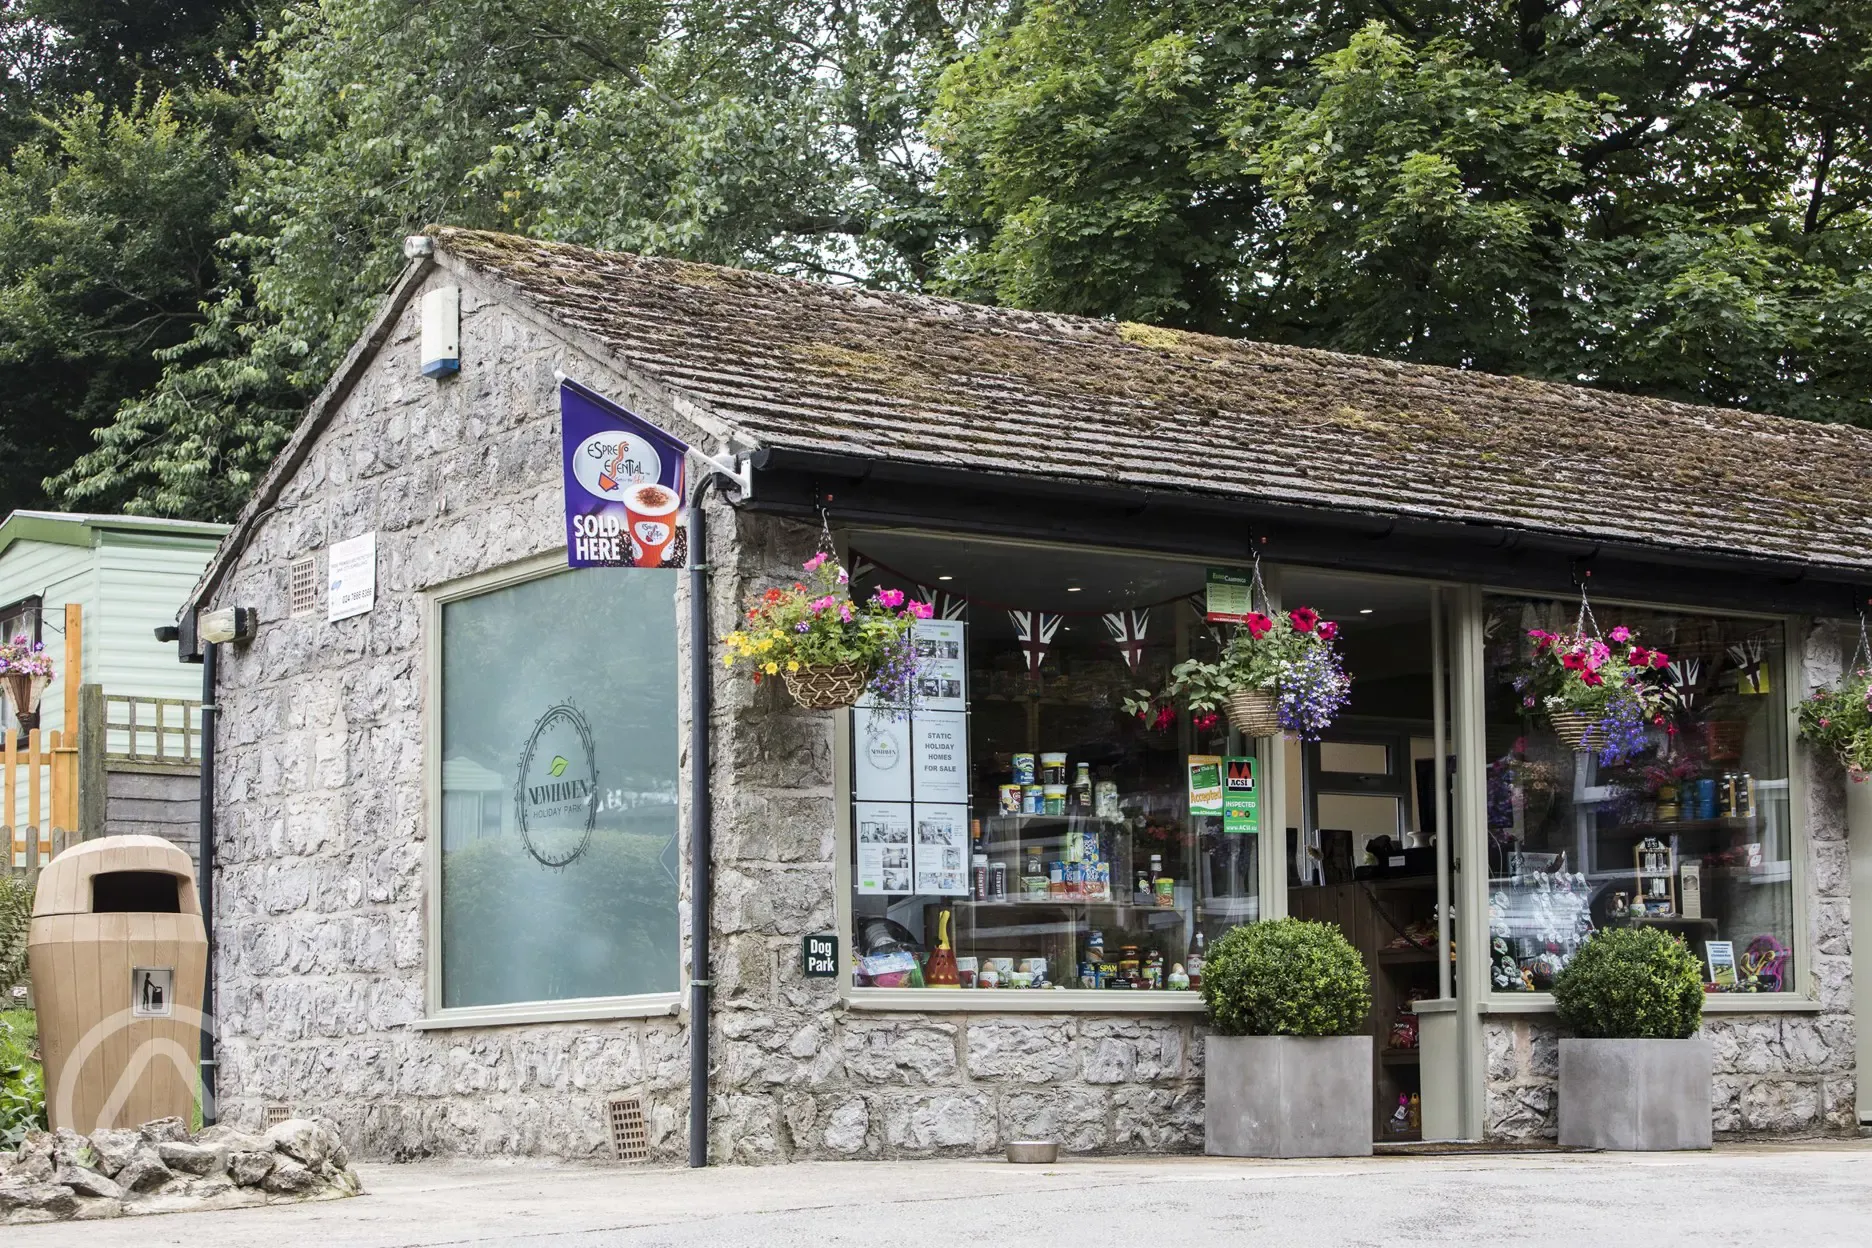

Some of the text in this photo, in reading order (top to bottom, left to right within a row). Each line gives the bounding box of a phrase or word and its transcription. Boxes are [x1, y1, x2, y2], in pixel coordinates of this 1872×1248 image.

[573, 514, 619, 537] SOLD
[576, 537, 621, 561] HERE
[927, 732, 952, 740] STATIC
[928, 753, 952, 761] HOMES
[939, 765, 957, 773] SALE
[528, 779, 590, 805] NEWHAVEN
[533, 804, 582, 818] HOLIDAY PARK
[810, 939, 832, 957] Dog
[808, 956, 835, 972] Park
[1099, 964, 1118, 973] SPAM
